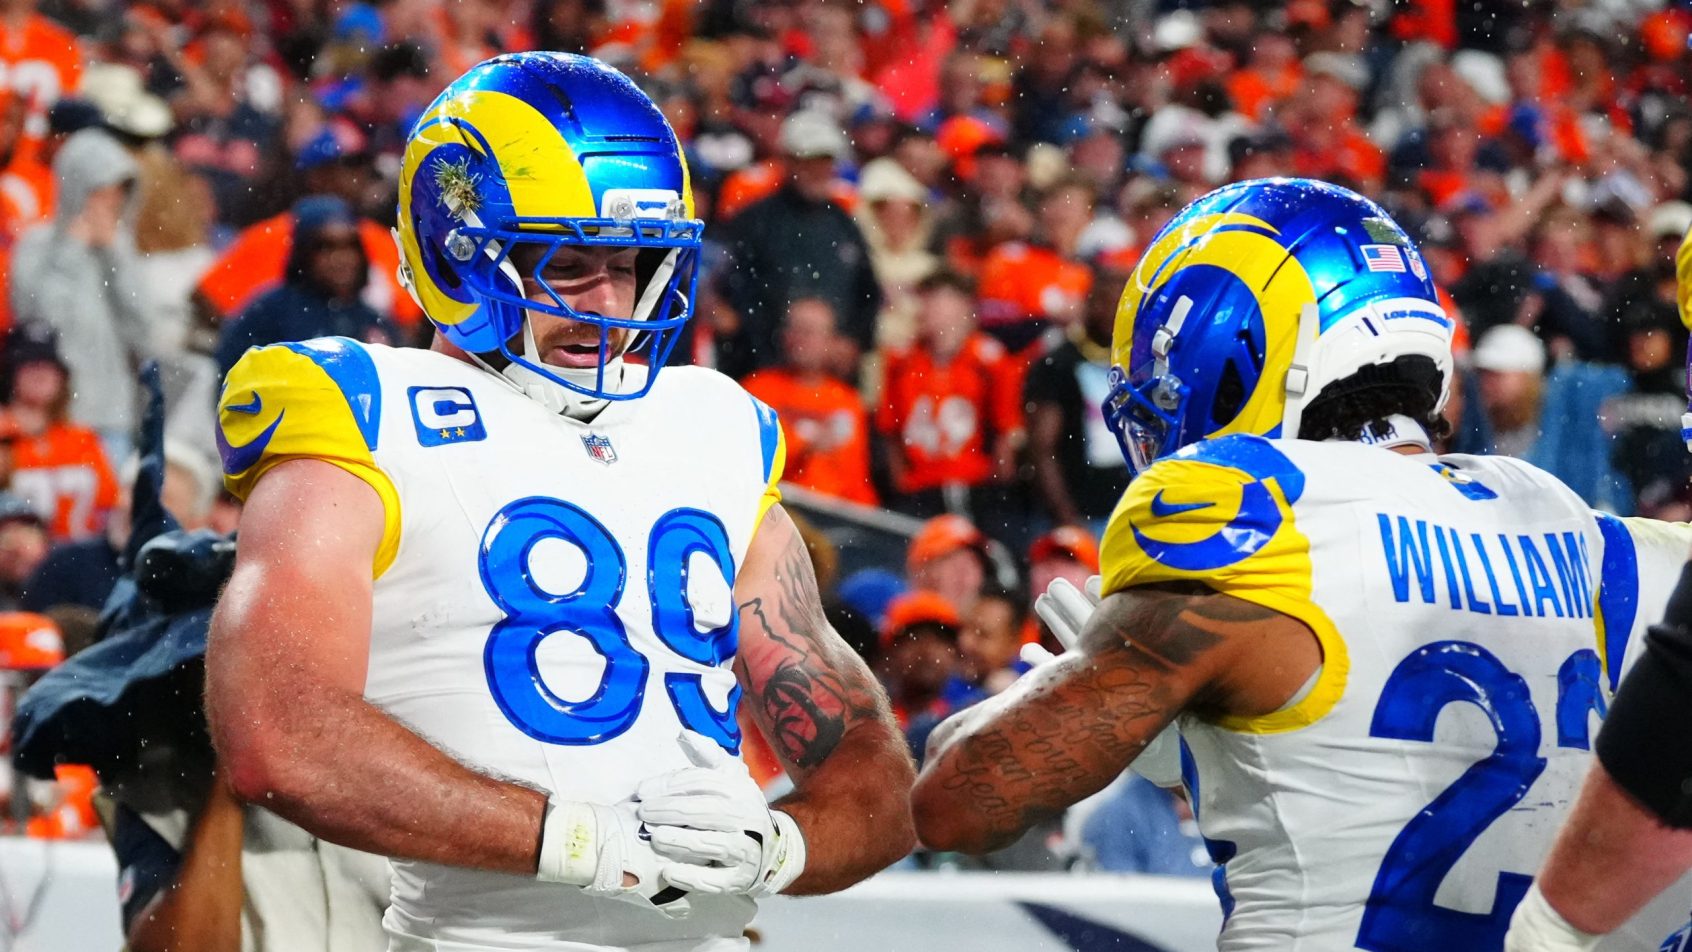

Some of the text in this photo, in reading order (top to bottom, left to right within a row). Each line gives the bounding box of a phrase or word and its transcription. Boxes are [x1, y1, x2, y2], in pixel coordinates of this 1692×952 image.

[415, 389, 476, 430] C
[1377, 512, 1594, 619] WILLIAM
[479, 496, 742, 757] 89
